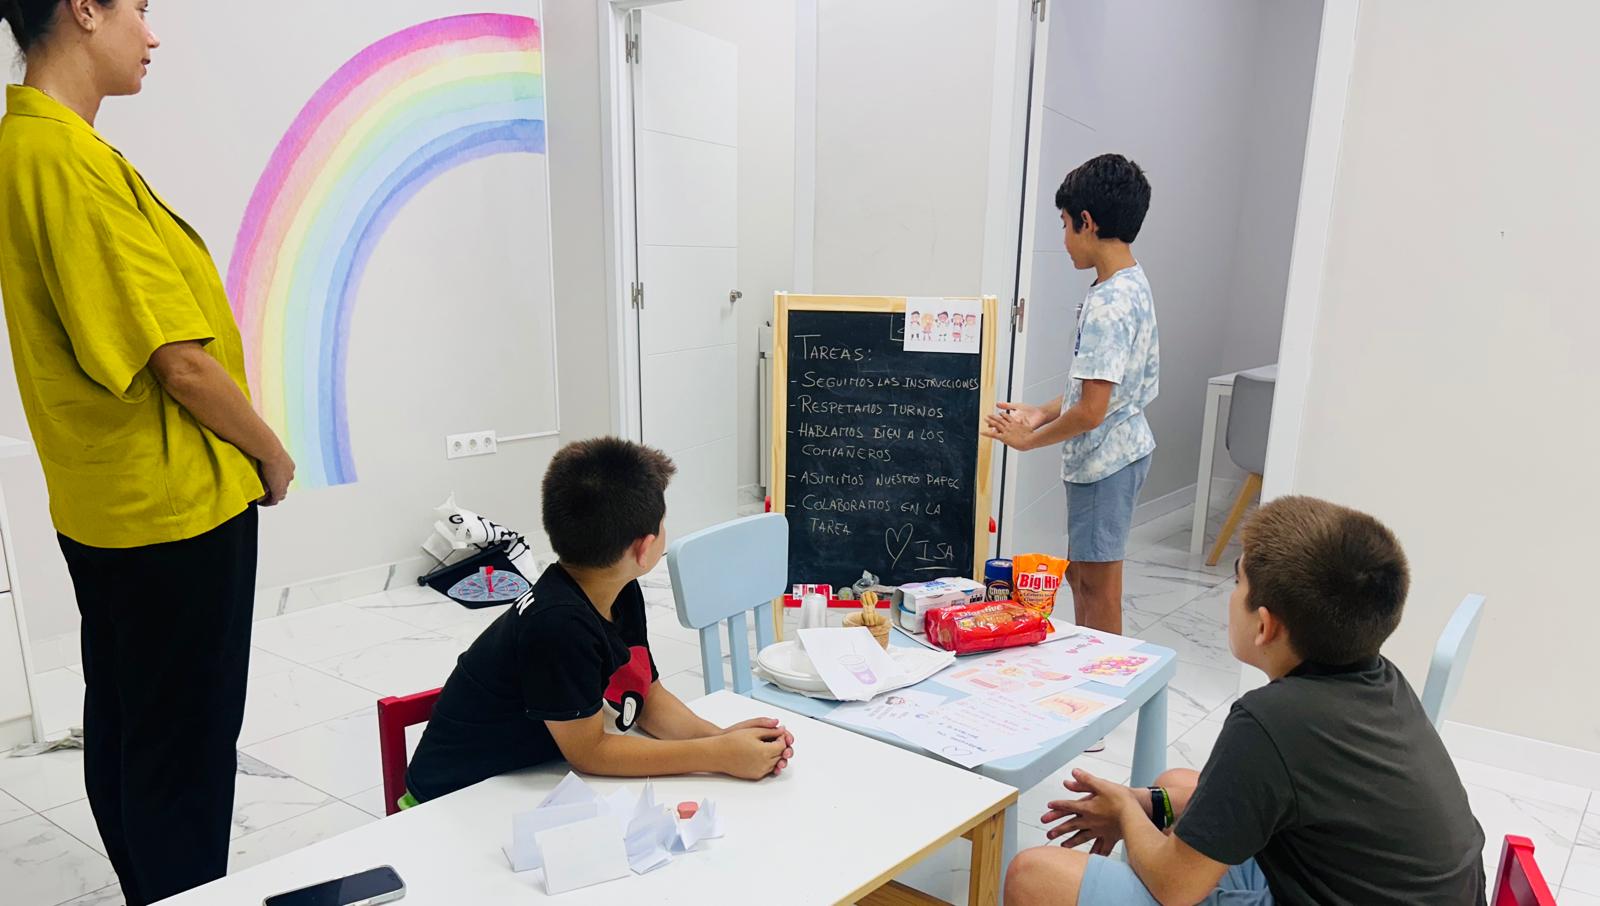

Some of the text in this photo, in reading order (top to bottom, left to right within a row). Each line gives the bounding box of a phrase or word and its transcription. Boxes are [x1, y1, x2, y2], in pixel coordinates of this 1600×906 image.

[794, 334, 872, 361] TAREAS:
[802, 371, 980, 391] SEGUIMOS LAS INSTRUCCIONES
[797, 395, 944, 419] RESPETAMOS TURNOS
[798, 423, 864, 439] HABLAMOS
[907, 430, 915, 440] A
[920, 430, 945, 443] LOS
[801, 444, 891, 462] COMPAÑEROS
[800, 472, 864, 486] ASUMIMOS
[876, 473, 920, 488] NUESTRO
[802, 494, 941, 515] COLABORAMOS EN LA
[809, 517, 852, 536] TAREA
[915, 540, 955, 562] ISA
[1018, 573, 1042, 591] Big
